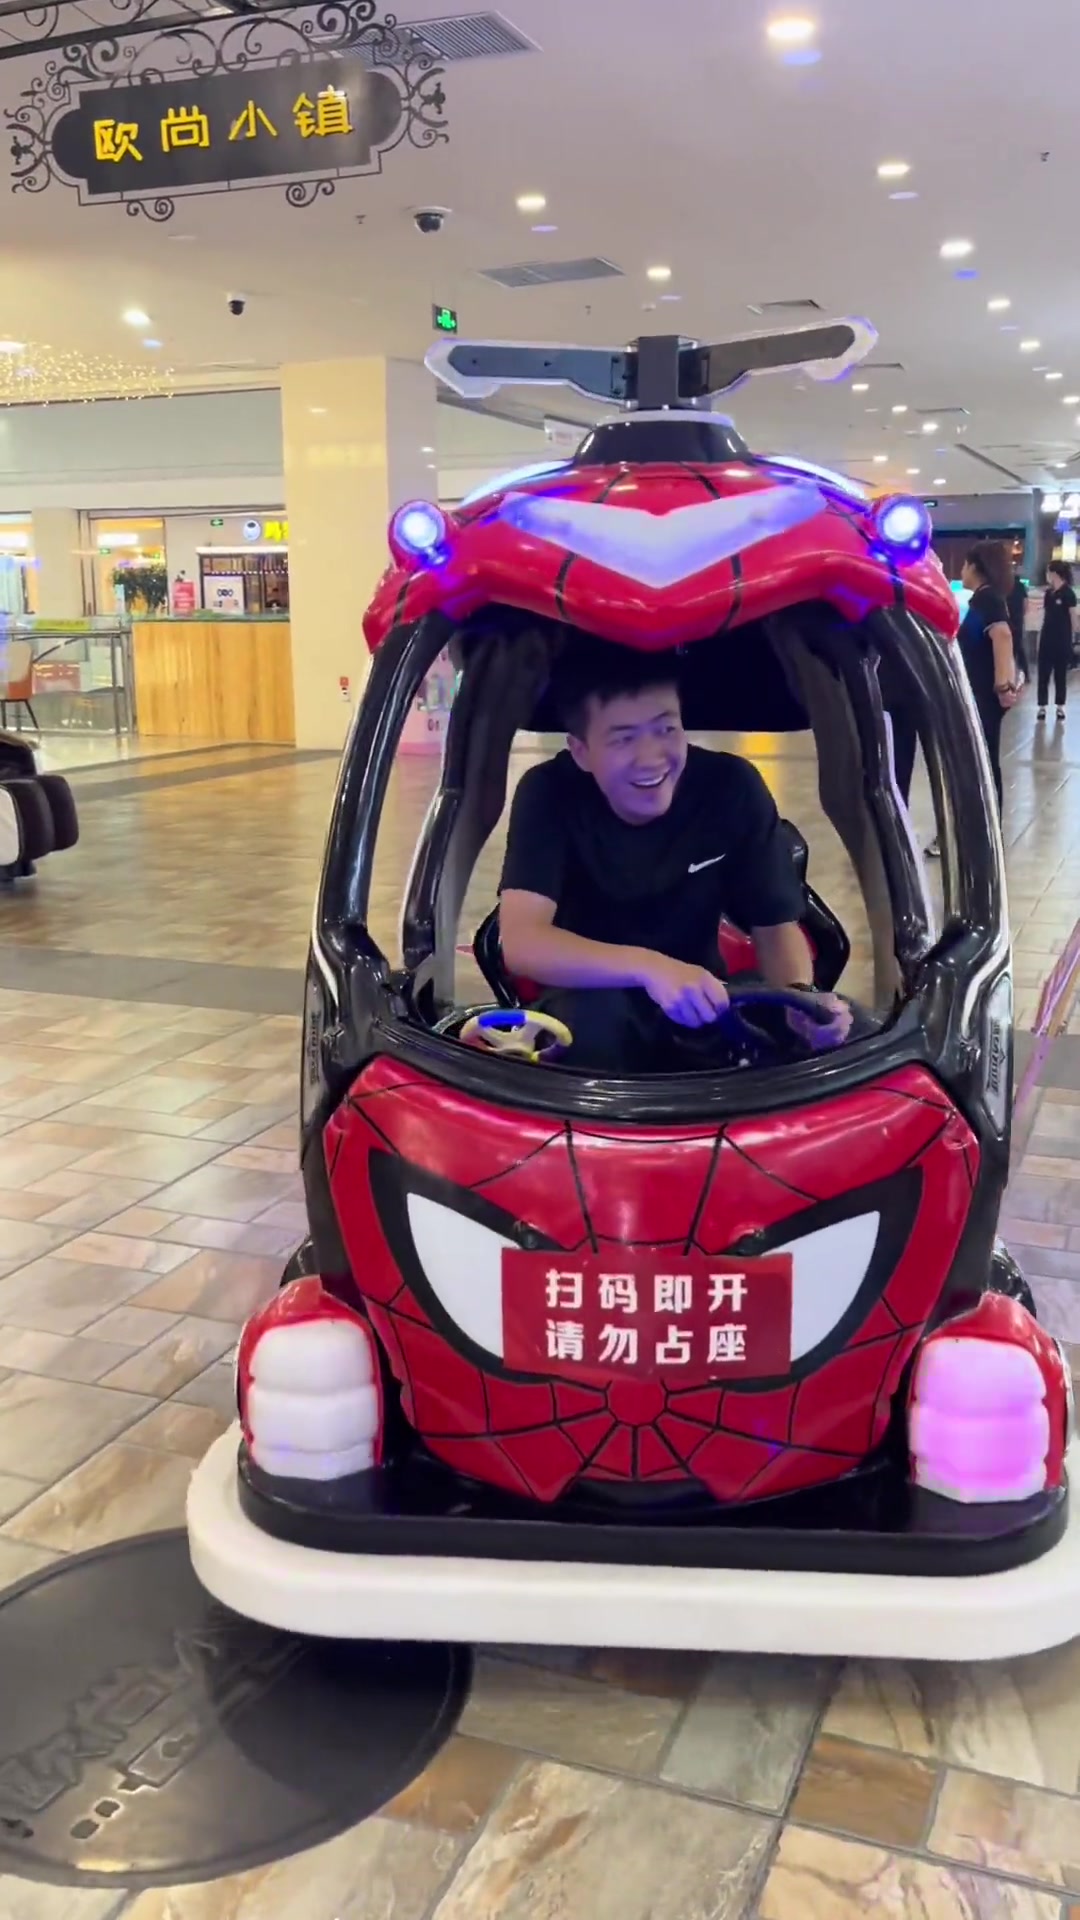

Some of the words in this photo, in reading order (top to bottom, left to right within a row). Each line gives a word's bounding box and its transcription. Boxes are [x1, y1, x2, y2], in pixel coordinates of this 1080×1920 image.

[93, 84, 354, 162] 欧尚小镇
[545, 1268, 748, 1313] 扫码即开
[545, 1319, 748, 1364] 请勿占座
